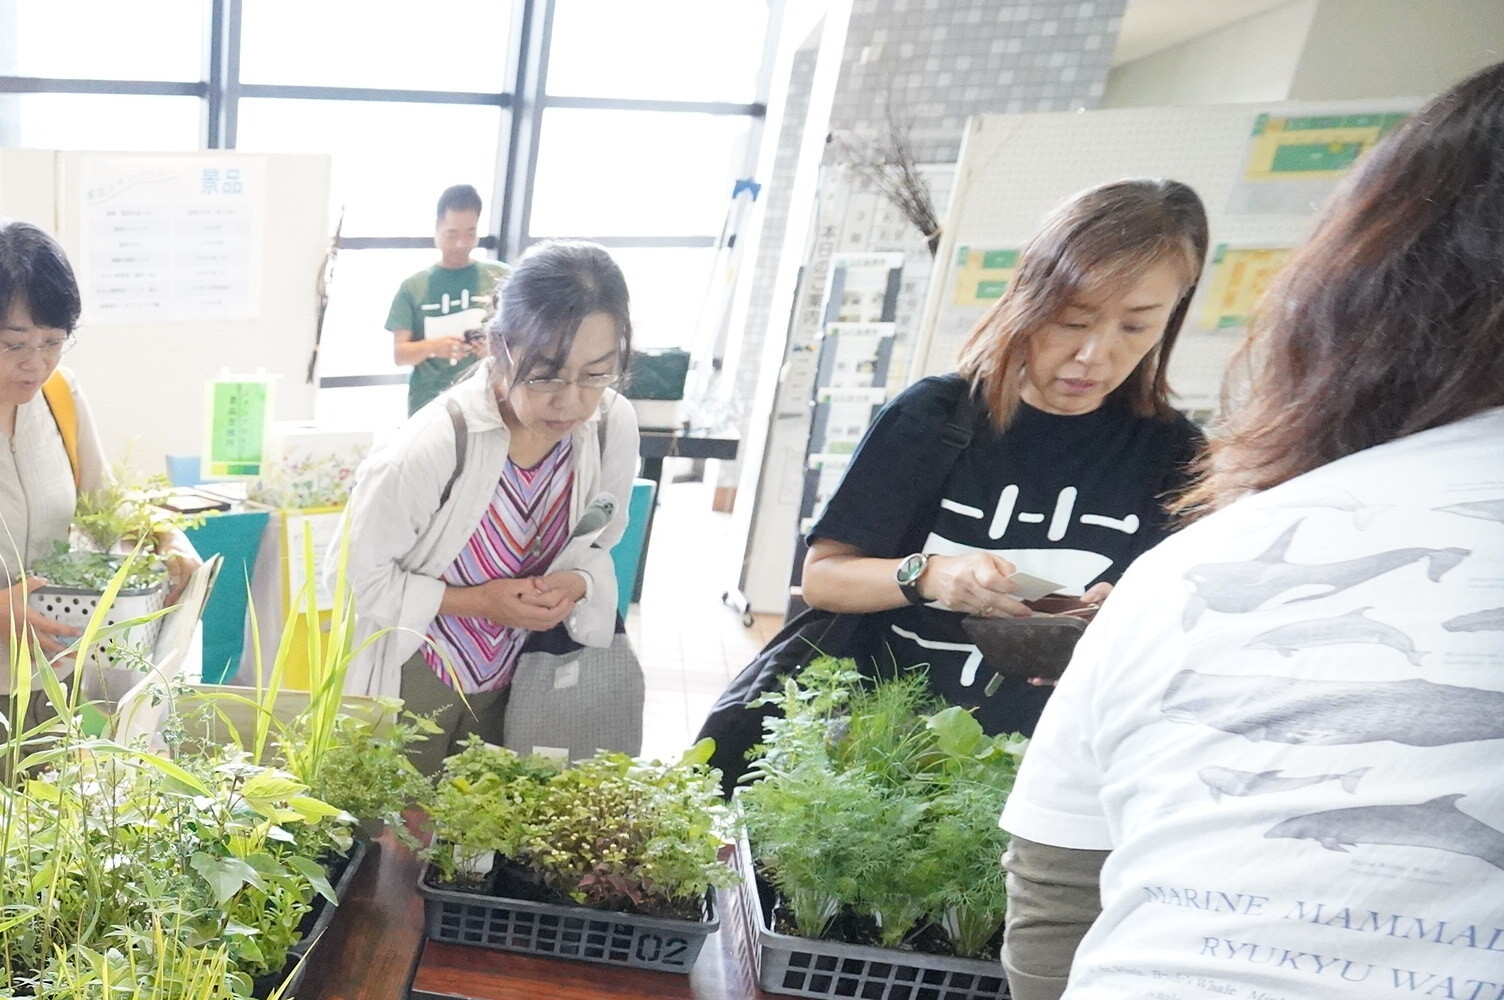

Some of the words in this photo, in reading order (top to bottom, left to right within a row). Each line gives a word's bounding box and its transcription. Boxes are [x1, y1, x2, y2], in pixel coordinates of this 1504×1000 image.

[201, 168, 243, 195] 景品
[1143, 886, 1270, 917] MARINE
[1285, 900, 1504, 953] MAMMAL
[635, 933, 689, 966] 02
[1199, 935, 1376, 982] RYUKYU
